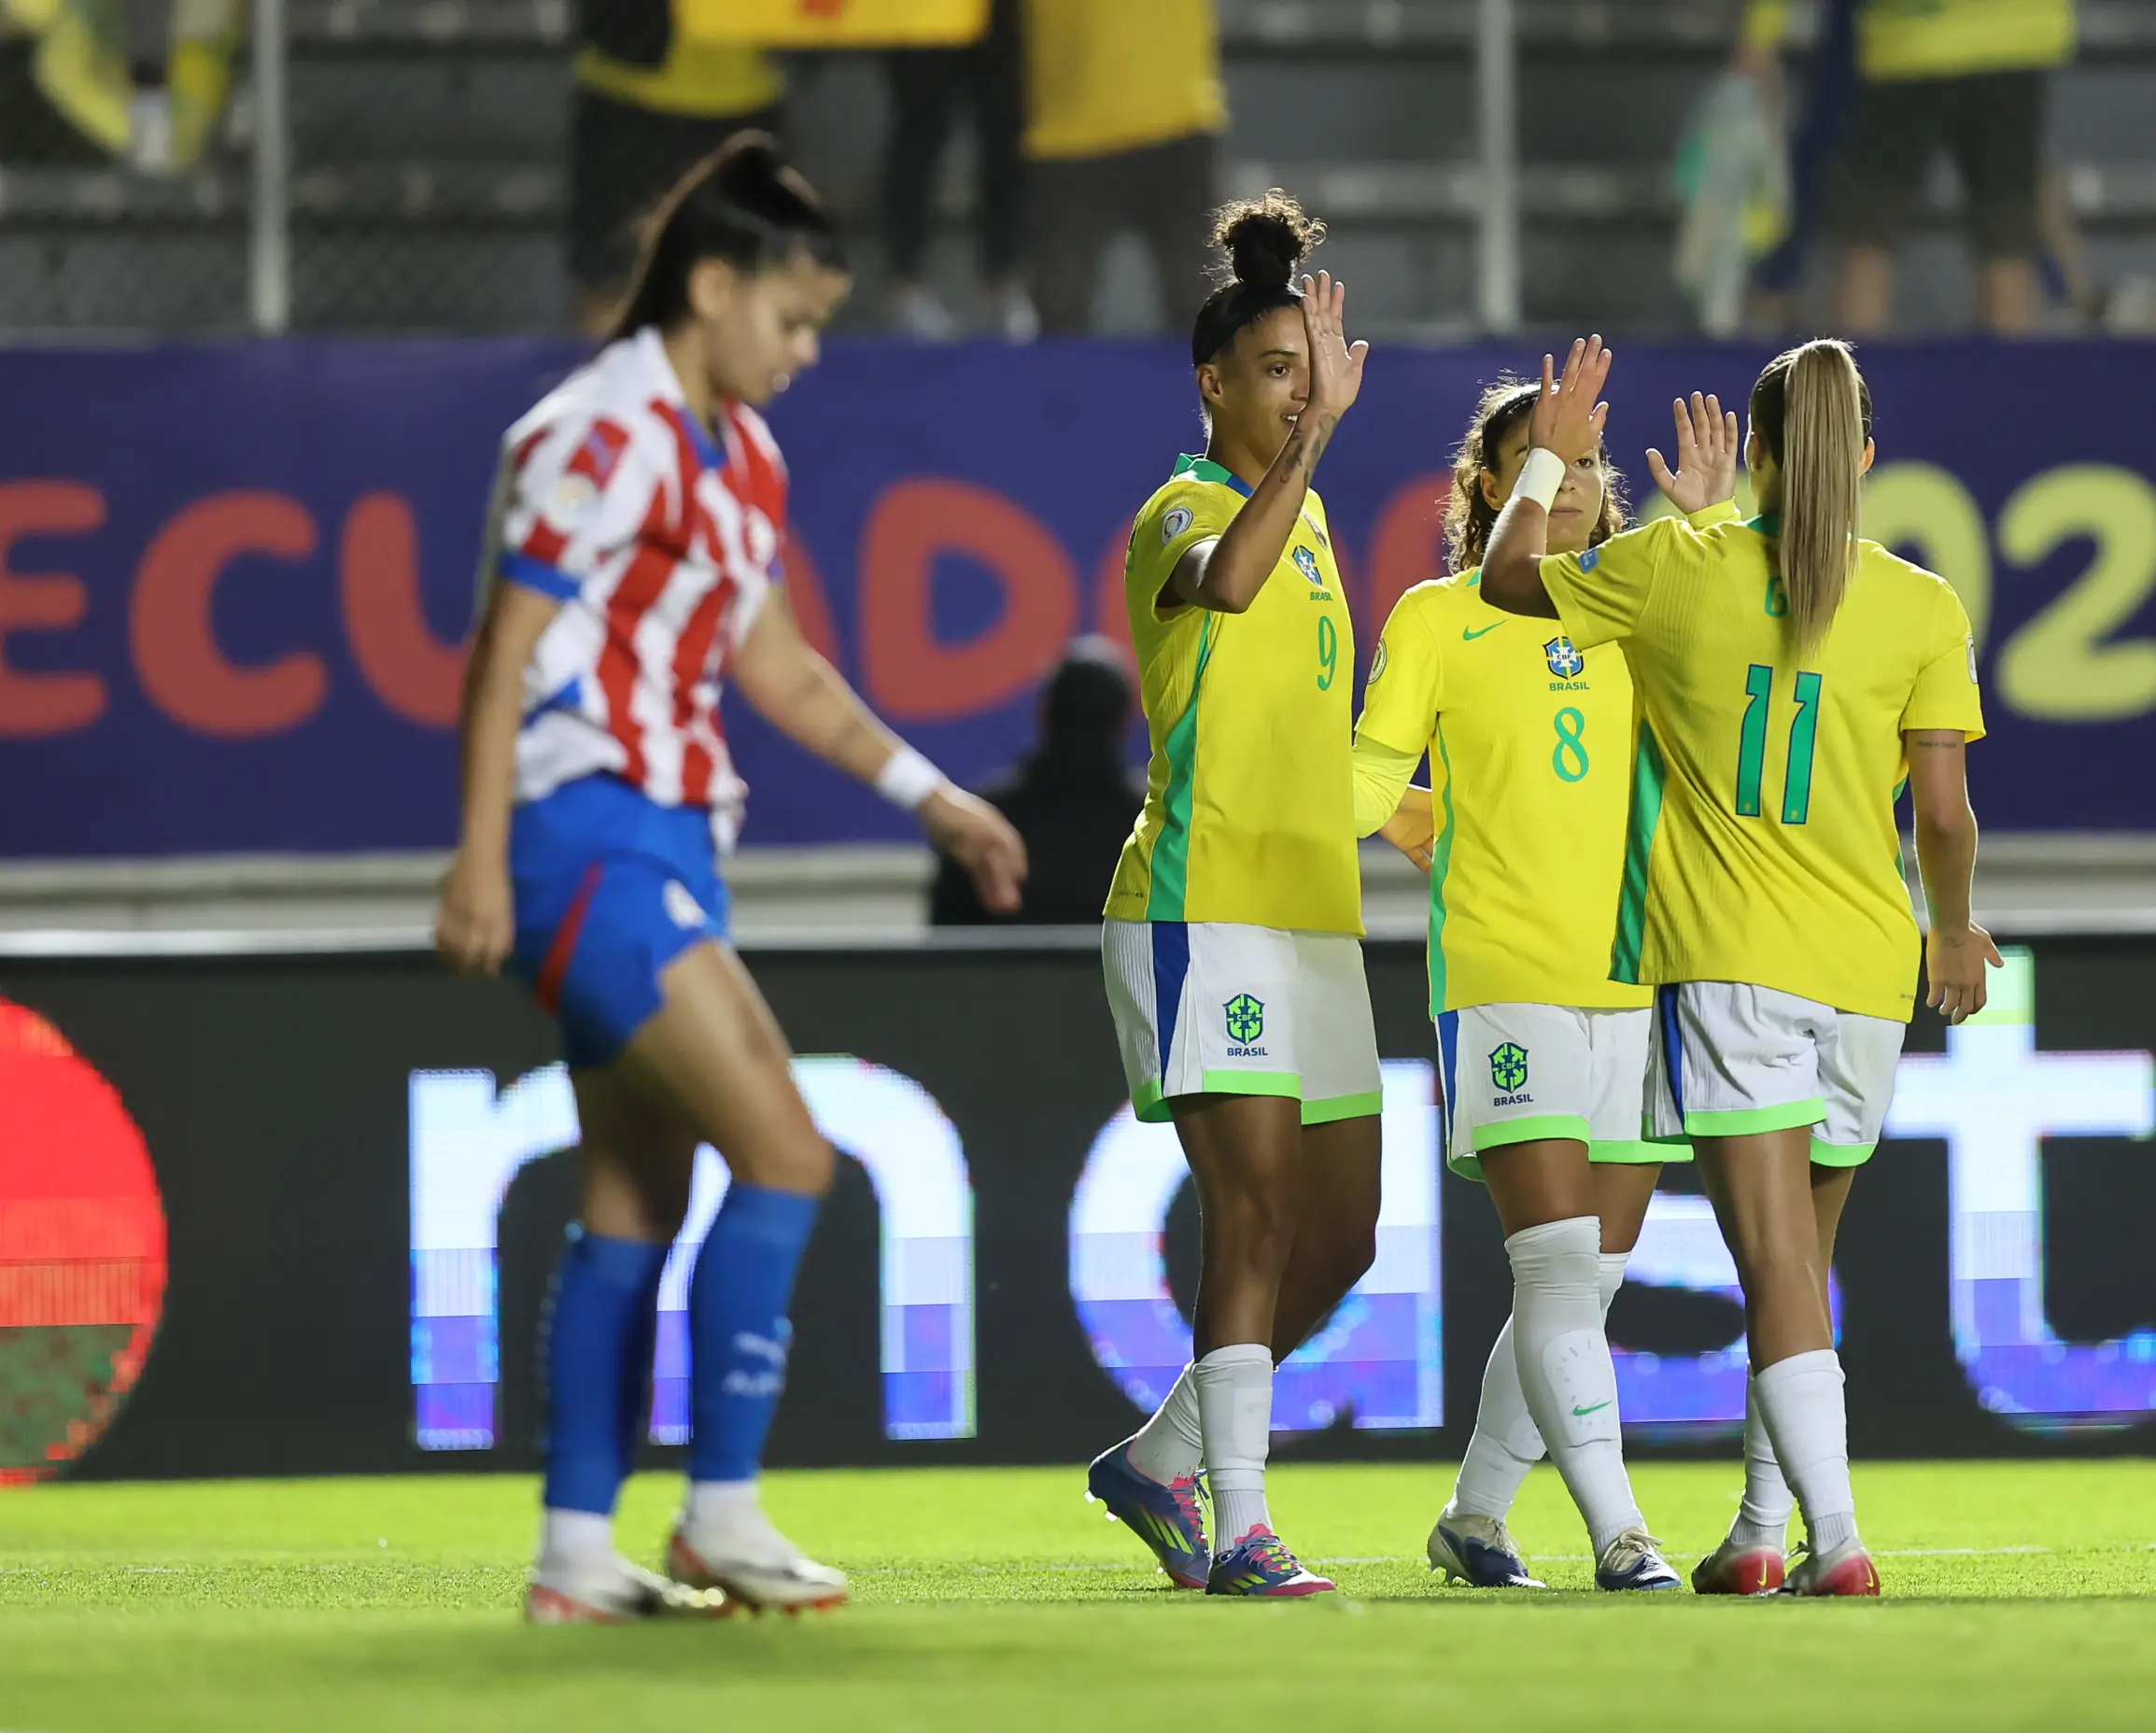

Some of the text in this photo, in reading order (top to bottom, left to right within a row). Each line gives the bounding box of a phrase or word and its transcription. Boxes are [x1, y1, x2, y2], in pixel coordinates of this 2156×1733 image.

[1309, 591, 1333, 601] BRASIL
[1317, 615, 1337, 691] 9
[1549, 681, 1590, 691] BRASIL
[1552, 707, 1589, 782] 8
[1736, 664, 1823, 824] 11
[1227, 1047, 1268, 1056] BRASIL
[1501, 1062, 1515, 1070] CBF
[1493, 1093, 1533, 1106] BRASIL
